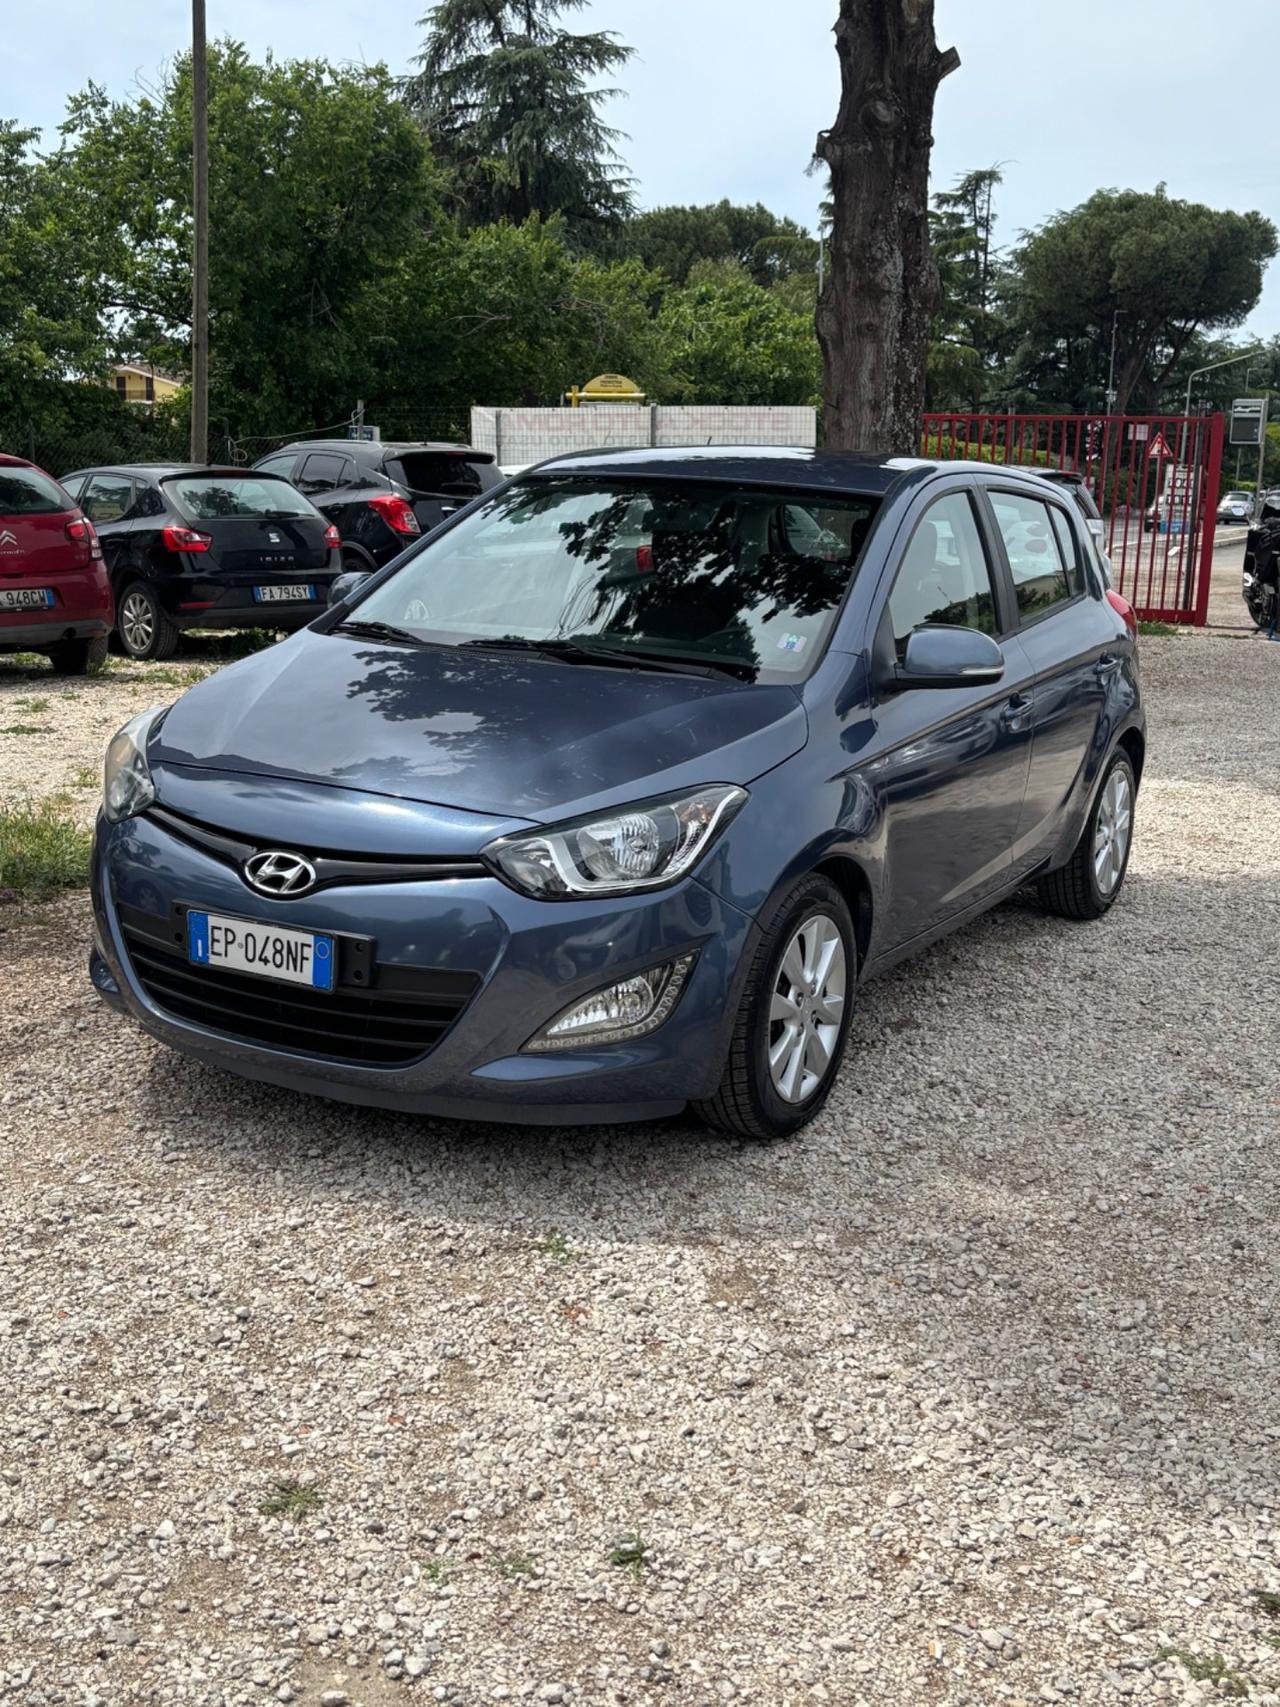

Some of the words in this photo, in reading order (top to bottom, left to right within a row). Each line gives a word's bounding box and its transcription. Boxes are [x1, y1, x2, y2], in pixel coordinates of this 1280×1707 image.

[261, 586, 276, 600] FA
[210, 925, 237, 958] EP
[244, 932, 312, 973] 048NF
